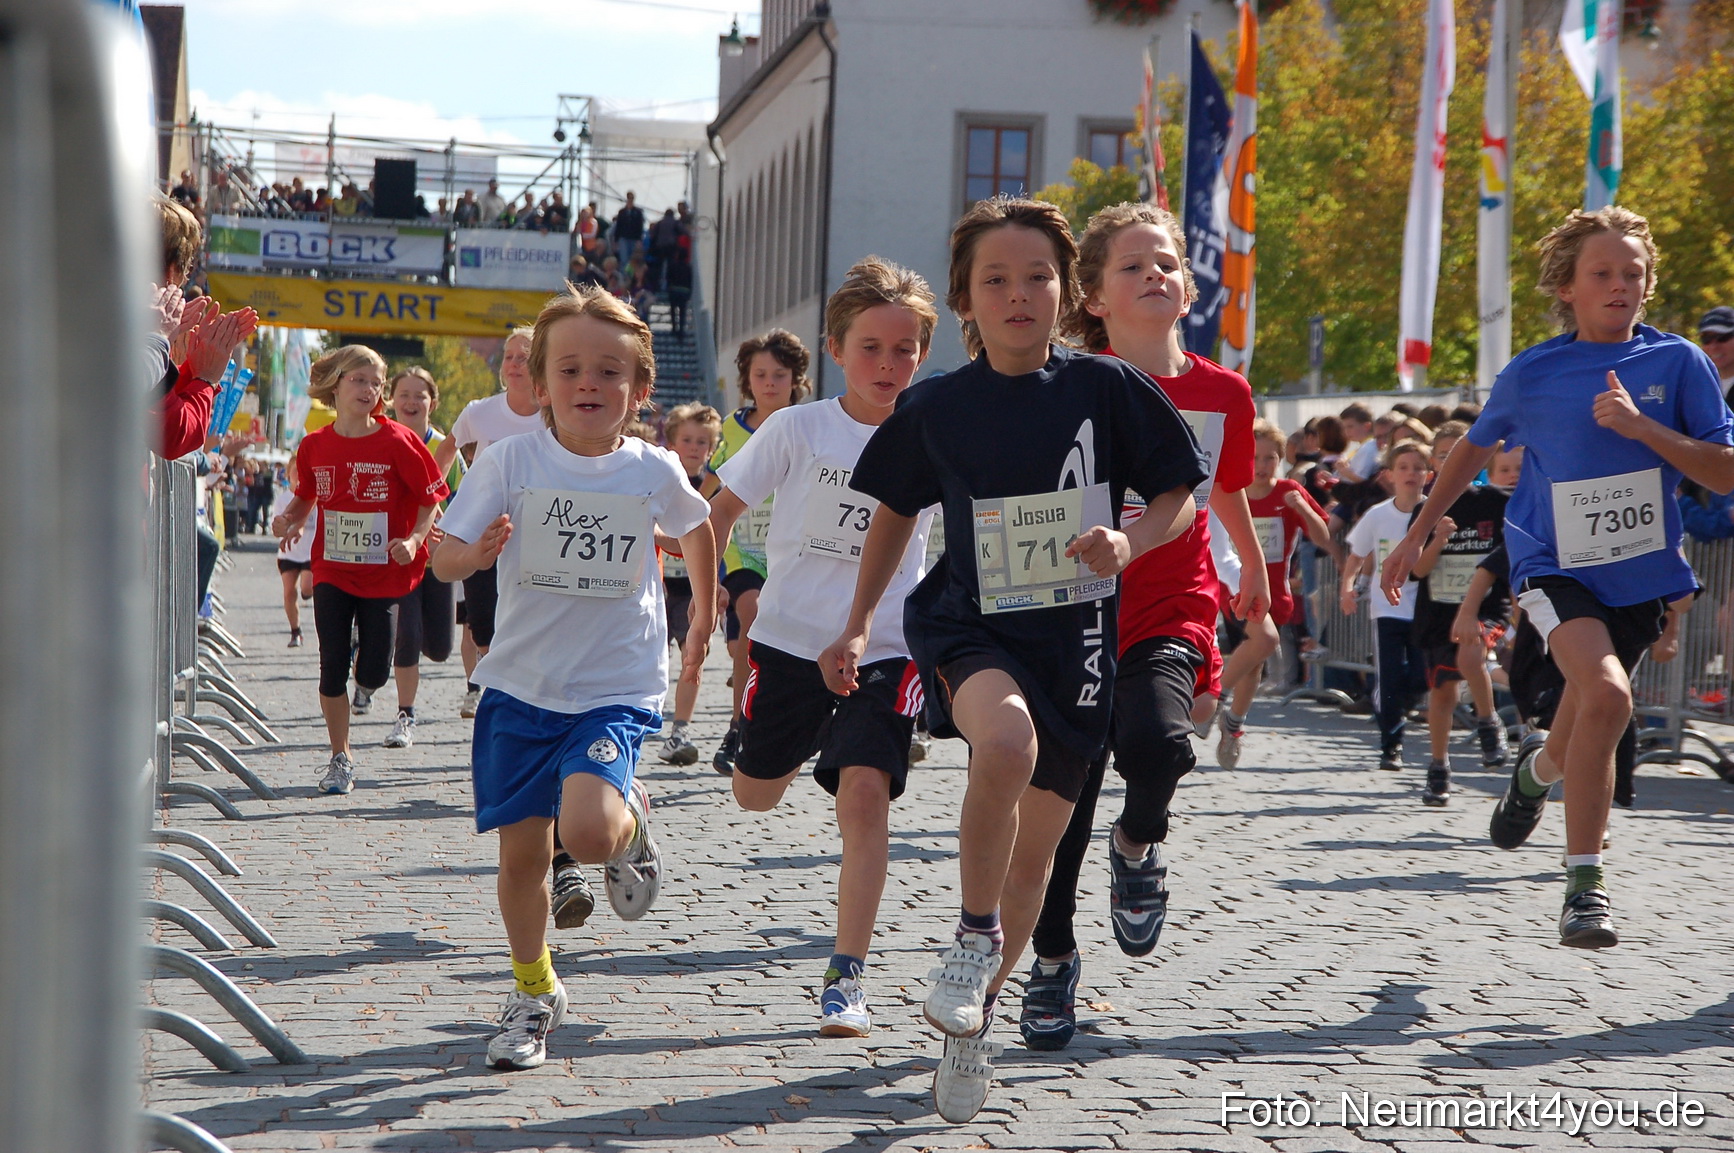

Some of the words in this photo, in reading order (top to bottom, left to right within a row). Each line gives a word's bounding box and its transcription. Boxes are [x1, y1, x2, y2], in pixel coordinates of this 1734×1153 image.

[263, 230, 396, 263] BOCK
[484, 246, 563, 263] PFLEIDERER
[324, 289, 445, 321] START
[1570, 486, 1634, 506] Tobias
[340, 516, 364, 529] Fanny
[542, 497, 608, 531] Alex
[1012, 505, 1066, 527] Josua
[1585, 502, 1655, 536] 7306
[341, 532, 382, 547] 7159
[558, 530, 637, 563] 7317
[590, 578, 630, 588] PFLEIDERER
[1069, 578, 1114, 596] PFLEIDERER
